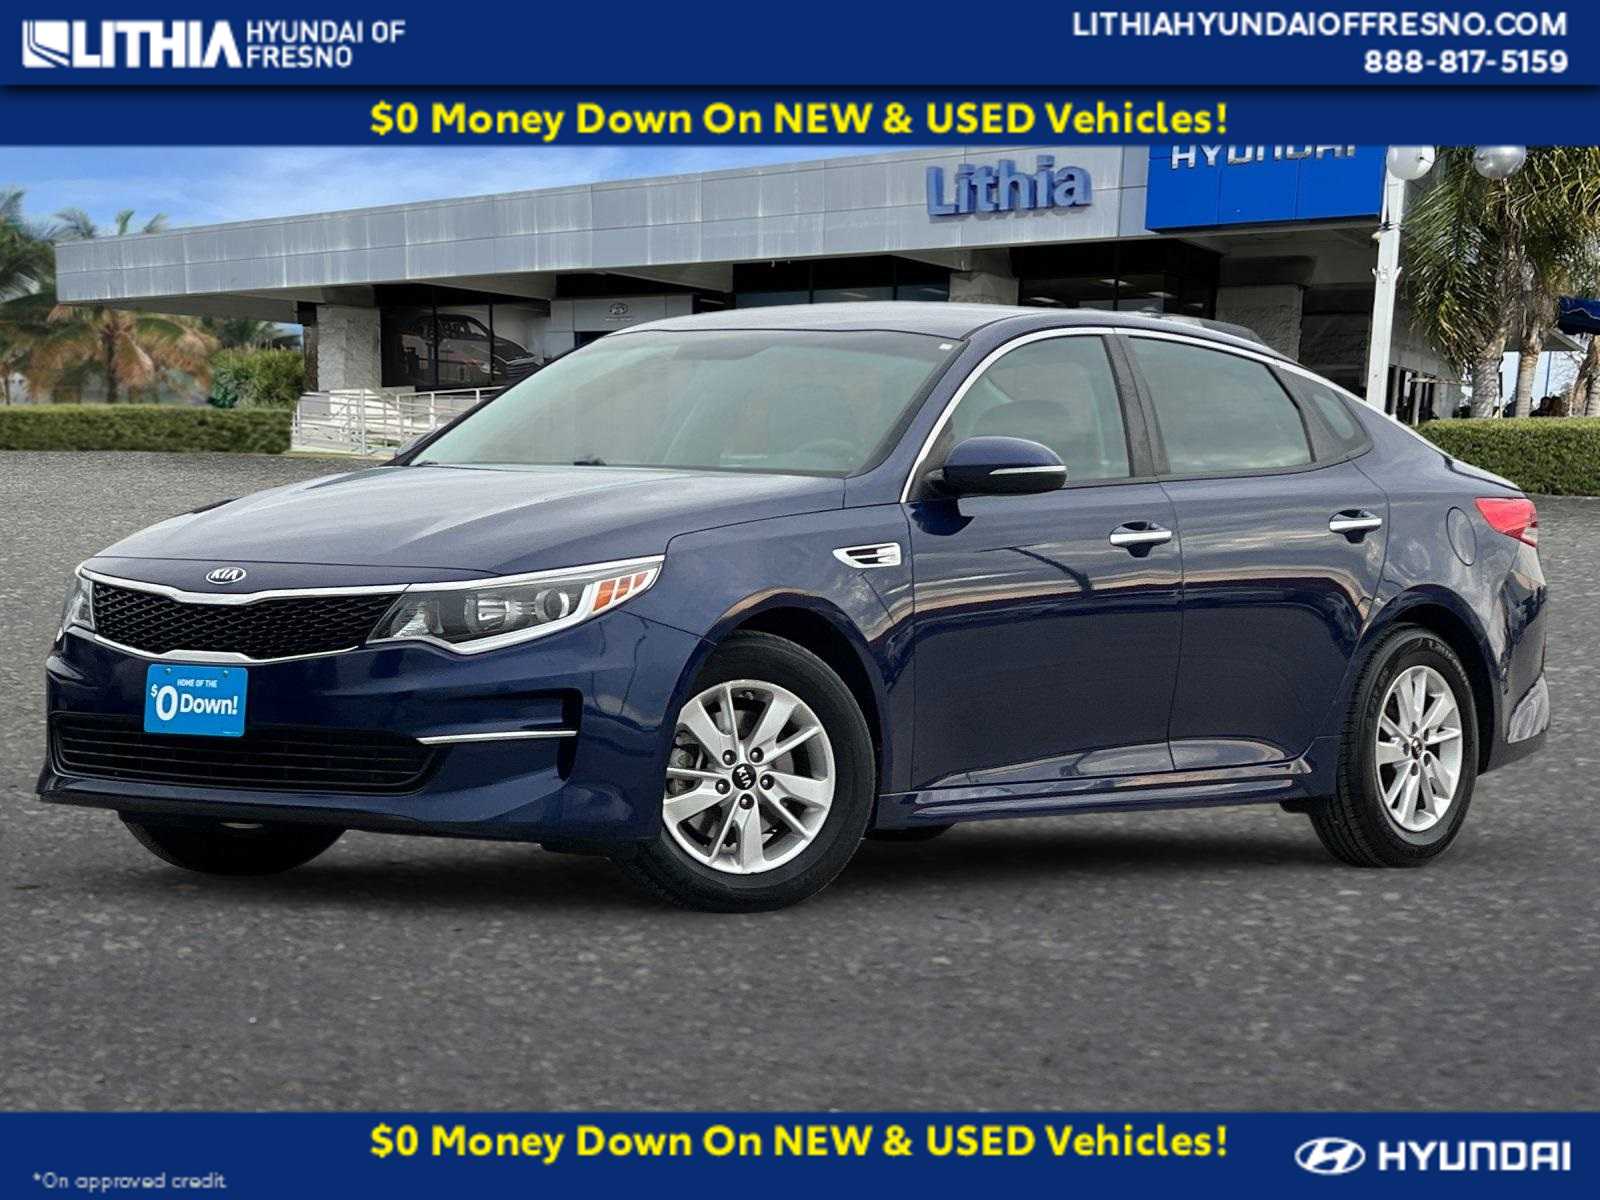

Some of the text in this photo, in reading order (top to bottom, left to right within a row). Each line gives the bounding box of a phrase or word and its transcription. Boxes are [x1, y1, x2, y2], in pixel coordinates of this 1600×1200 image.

[926, 155, 1093, 216] Lithia
[210, 568, 239, 580] KIA
[177, 679, 218, 688] HOME OF THE
[180, 693, 239, 715] Down!
[736, 766, 752, 788] KIA
